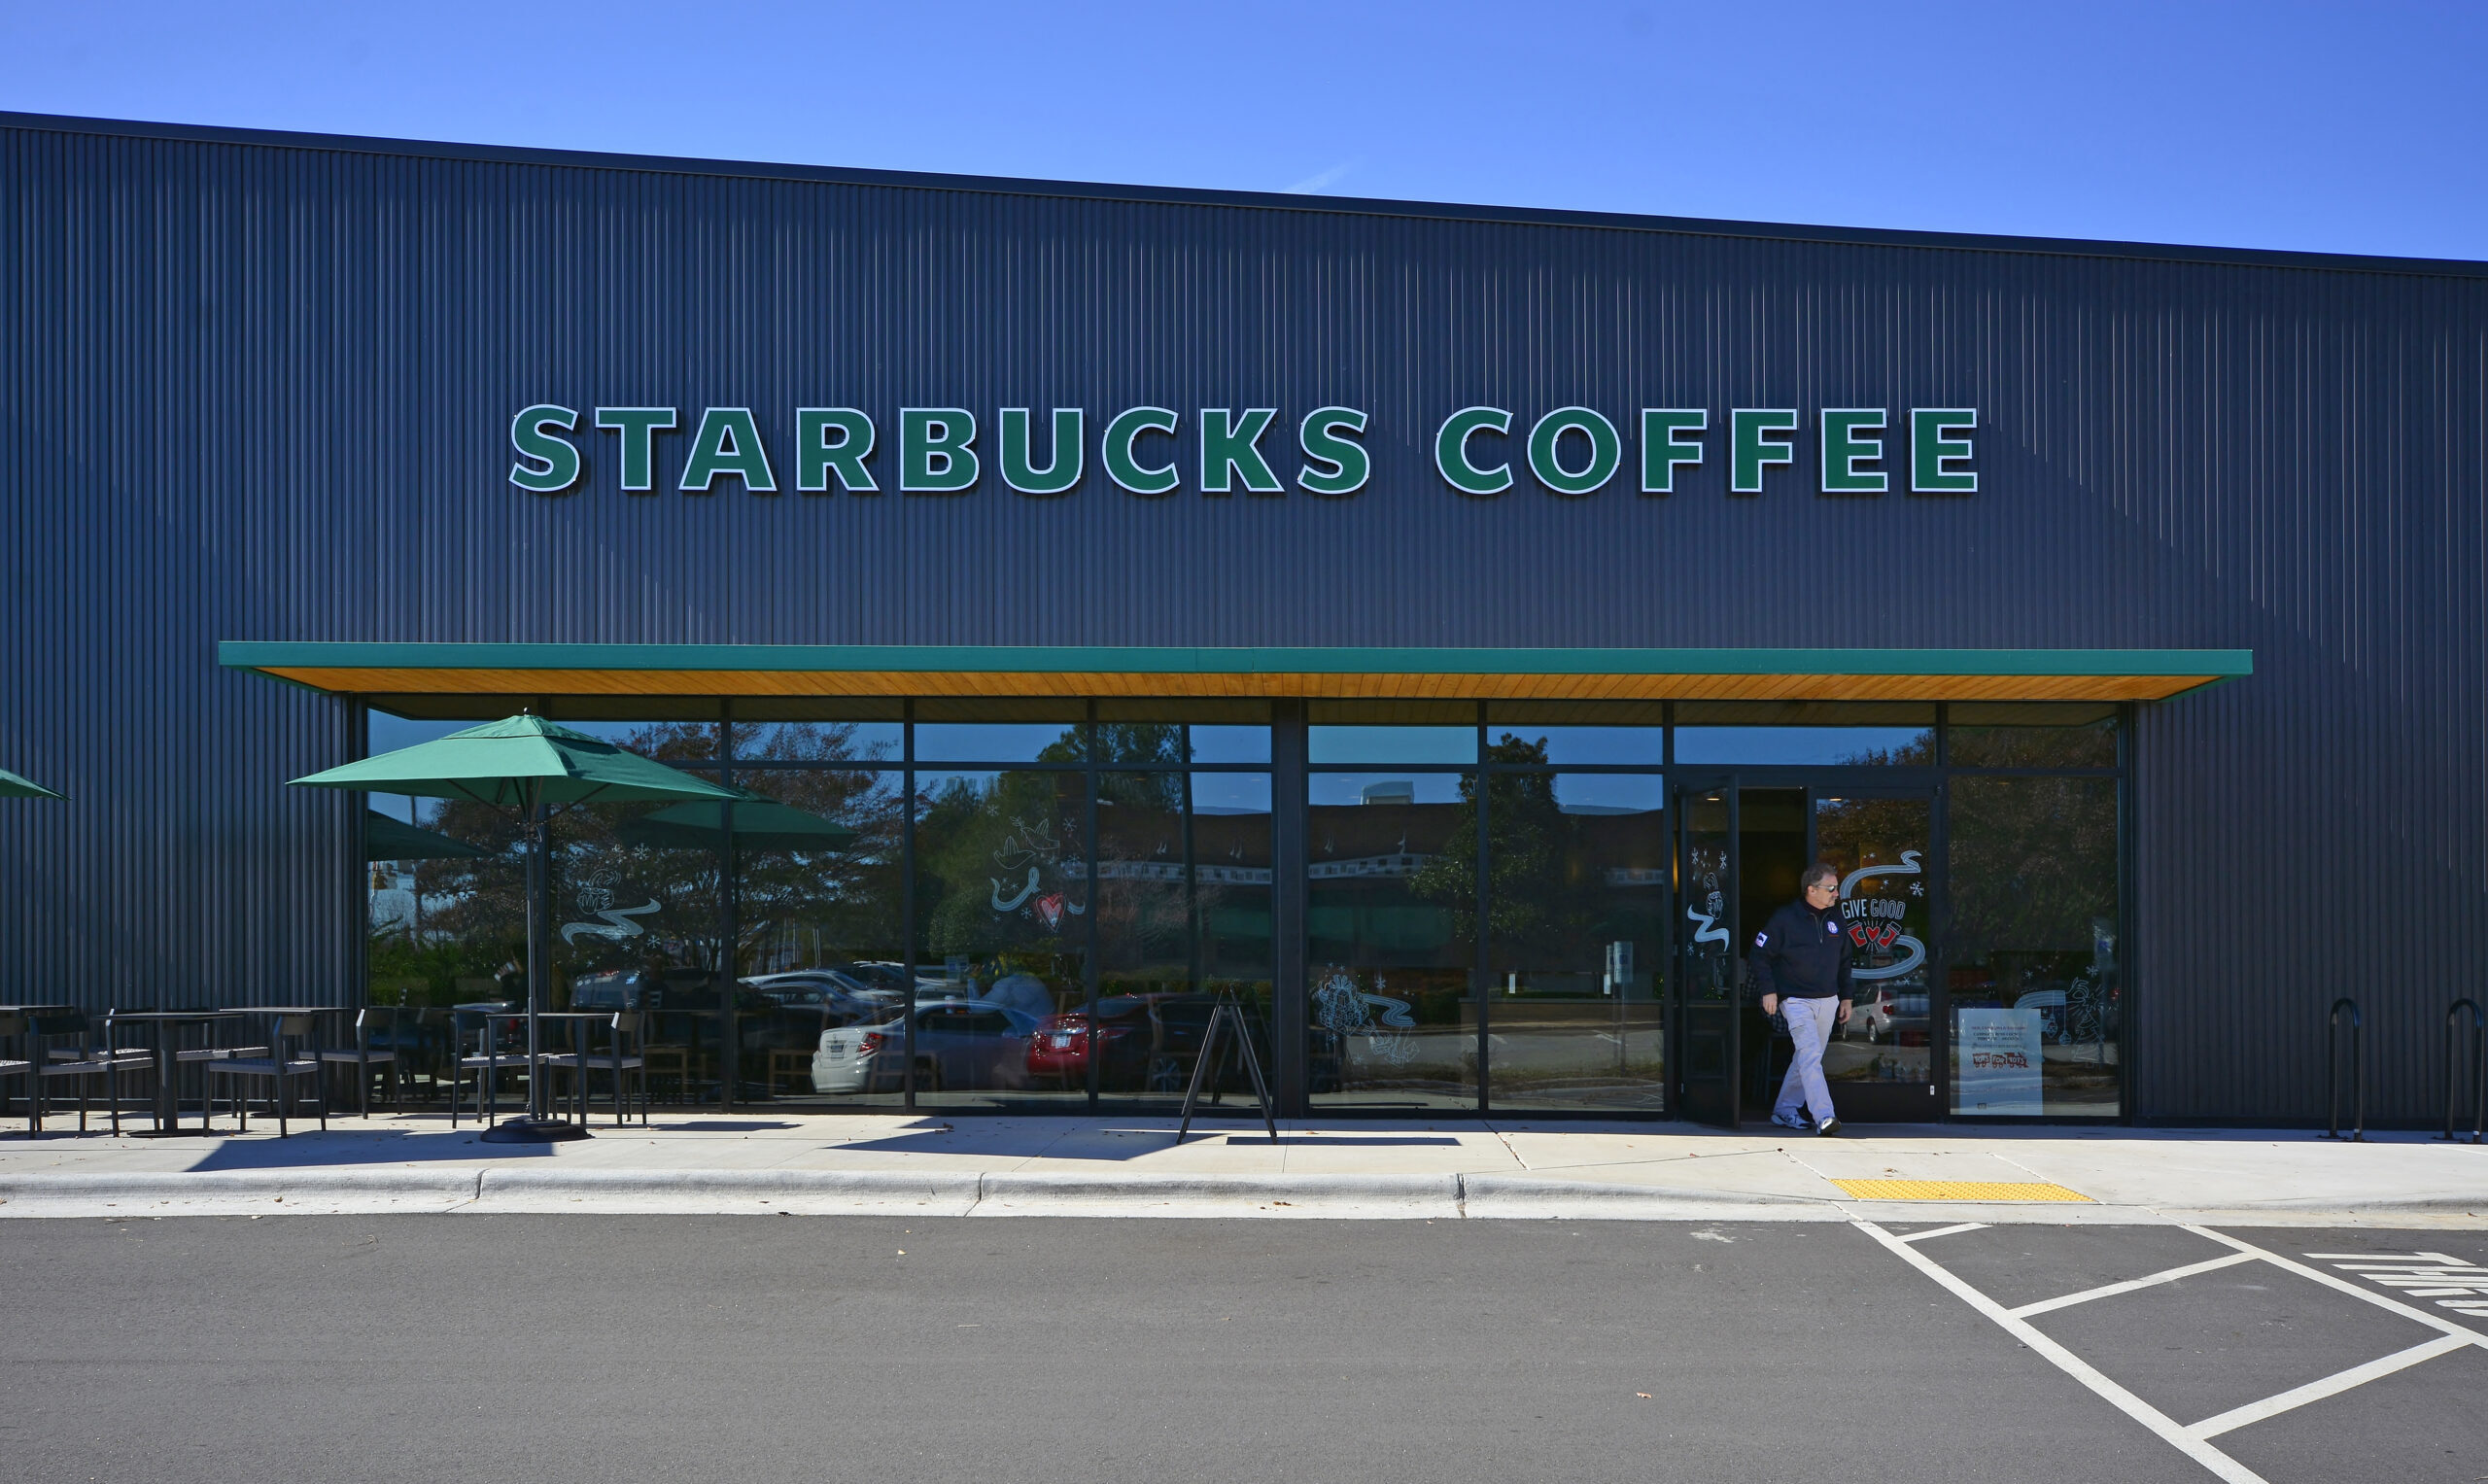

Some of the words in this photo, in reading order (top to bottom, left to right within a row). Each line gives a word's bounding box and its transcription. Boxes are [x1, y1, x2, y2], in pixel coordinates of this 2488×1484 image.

[509, 403, 1371, 495] STARBUCKS
[1434, 405, 1979, 495] COFFEE
[1841, 899, 1867, 918] GIVE
[1870, 899, 1906, 920] GOOD
[2300, 1252, 2488, 1318] THR
